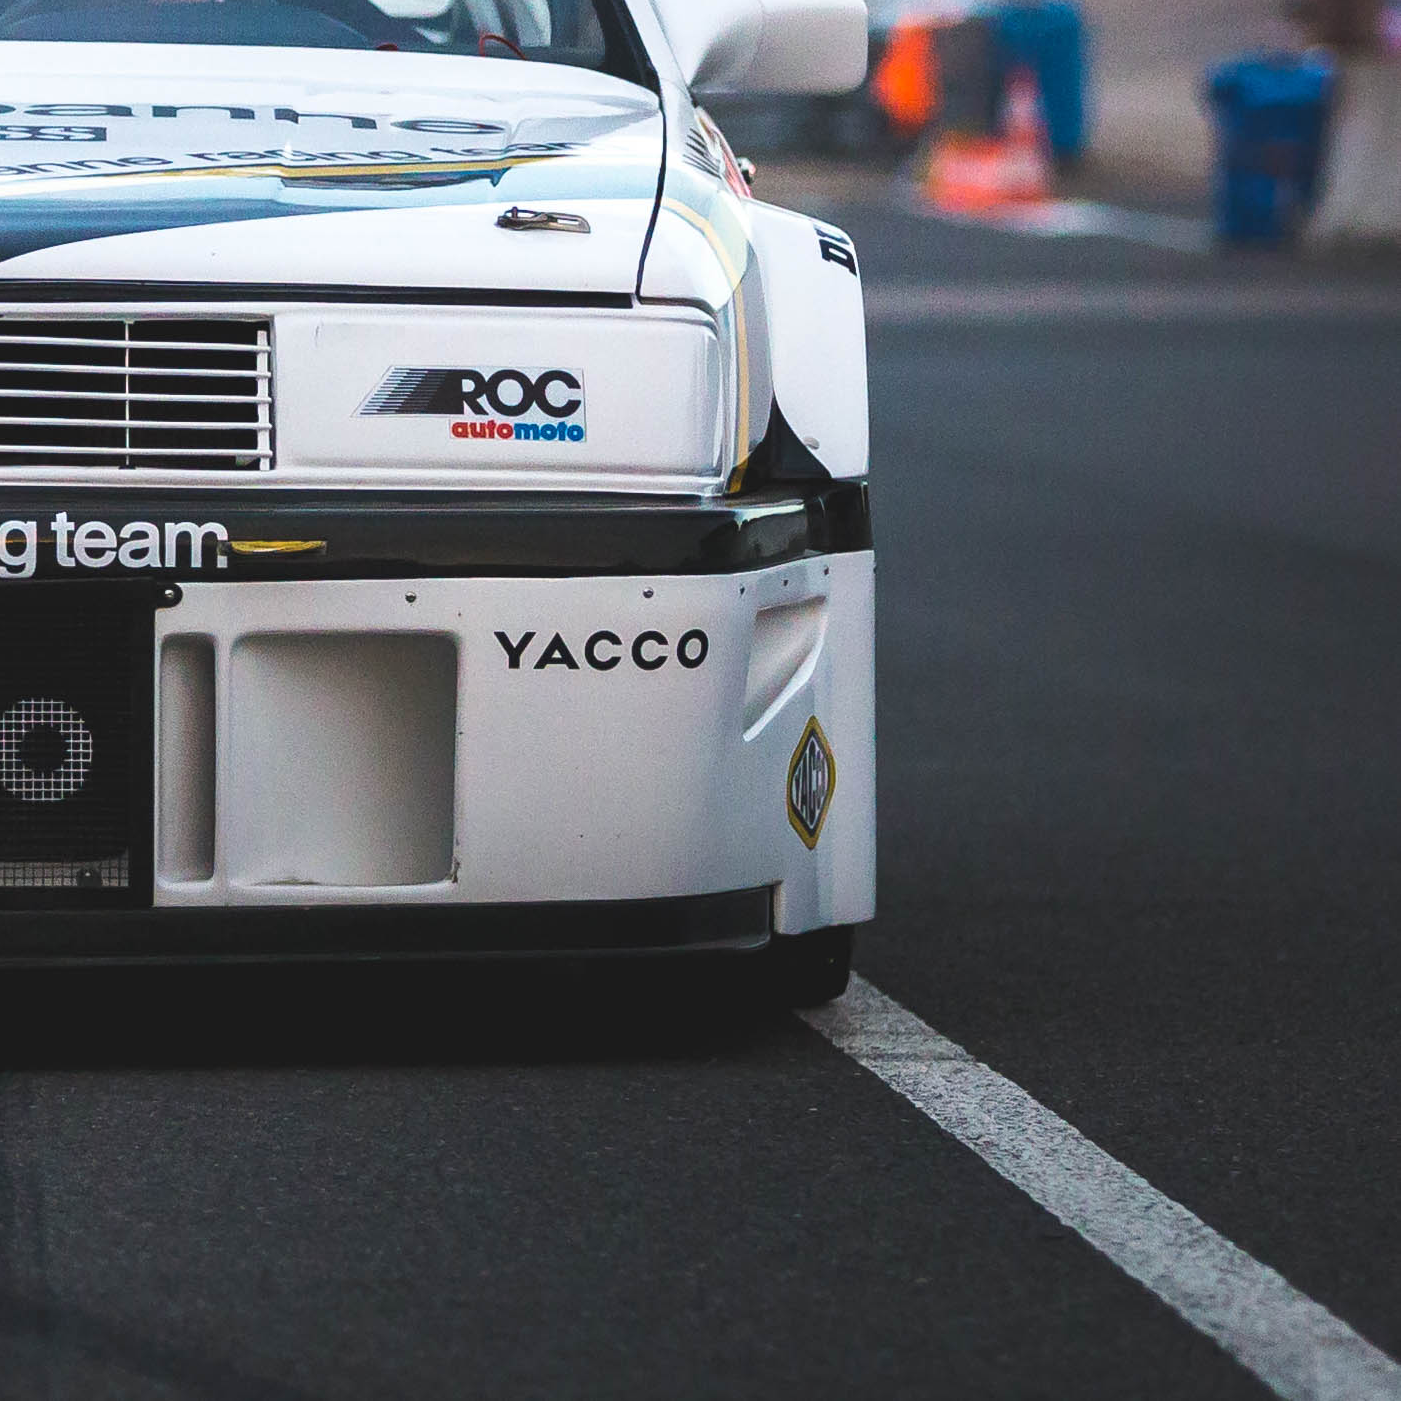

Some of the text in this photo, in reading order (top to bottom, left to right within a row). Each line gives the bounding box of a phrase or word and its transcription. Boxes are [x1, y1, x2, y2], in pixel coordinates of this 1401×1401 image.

[429, 369, 582, 418] ROC
[451, 420, 585, 442] automoto
[50, 510, 229, 569] team
[493, 628, 709, 672] YACCO
